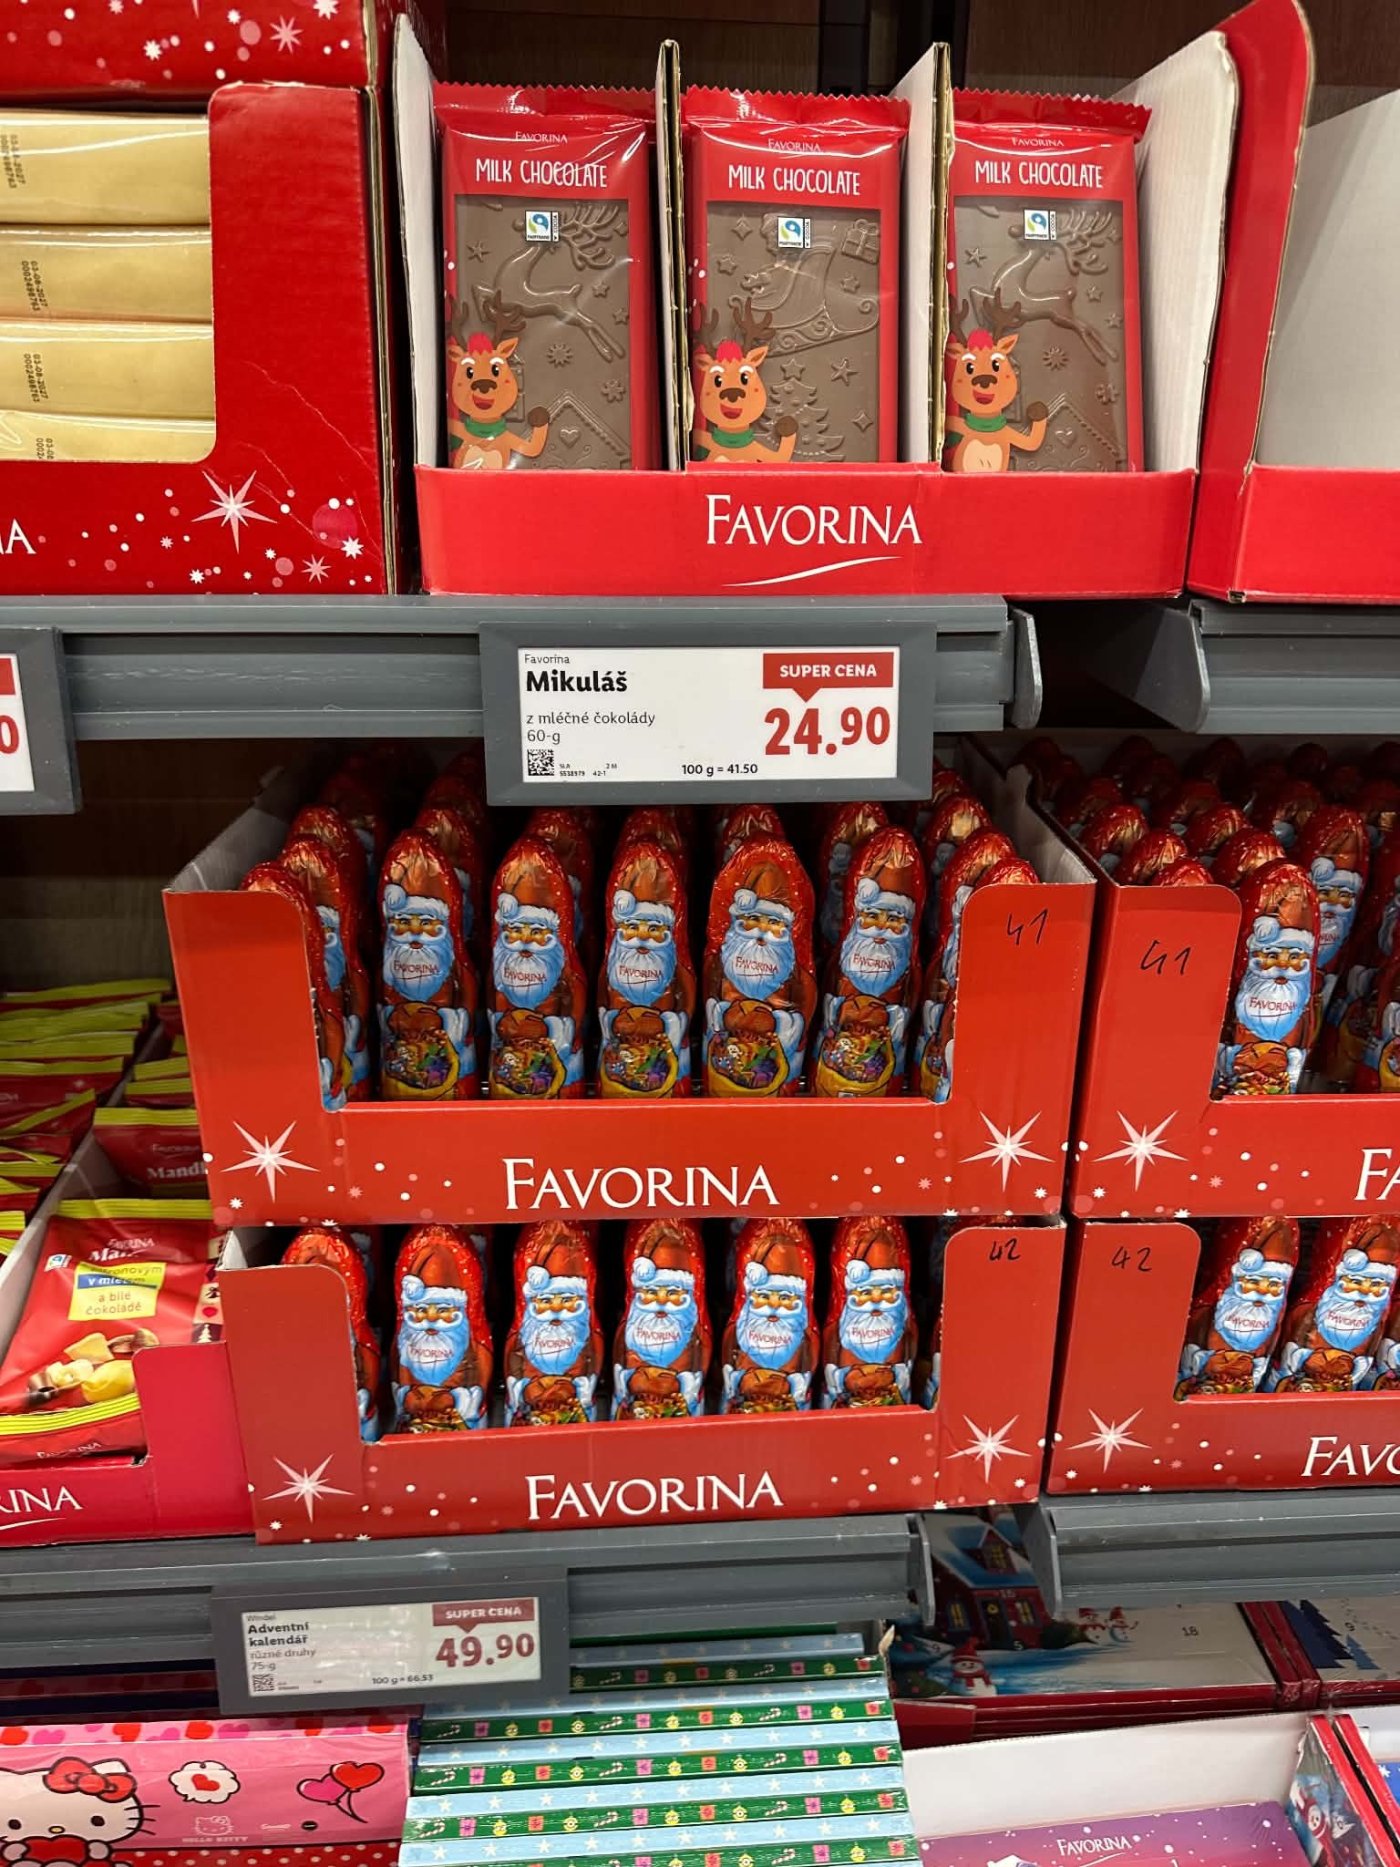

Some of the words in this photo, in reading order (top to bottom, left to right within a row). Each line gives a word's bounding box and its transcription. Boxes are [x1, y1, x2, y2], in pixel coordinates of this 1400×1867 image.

[515, 131, 568, 143] FAVORINA
[1011, 136, 1064, 148] FAVORINA
[768, 138, 821, 152] FAVORINA
[476, 158, 512, 182] MILK
[520, 159, 607, 188] CHOCOLATE
[728, 164, 765, 190] MILK
[773, 167, 860, 196] CHOCOLATE
[975, 160, 1011, 185] MILK
[1018, 161, 1103, 189] CHOCOLATE
[705, 494, 923, 545] FAVORINA
[524, 653, 571, 664] Favorina
[779, 664, 831, 678] SUPER
[834, 663, 878, 677] CENA
[526, 669, 628, 692] Mikuláš
[526, 714, 534, 724] z
[538, 711, 590, 725] mléčné
[593, 711, 656, 728] čokolády
[527, 729, 561, 745] 60-g
[764, 706, 891, 756] 24.90
[681, 764, 703, 775] 100
[706, 766, 715, 777] g
[727, 763, 759, 775] 41.50
[393, 960, 440, 974] FAVORINA
[619, 965, 662, 978] FAVORINA
[735, 956, 779, 973] FAVORINA
[503, 967, 548, 982] FAVORINA
[1249, 996, 1297, 1011] FAVORINA
[502, 1157, 781, 1210] FAVORINA
[989, 1237, 1023, 1262] 42
[1111, 1246, 1153, 1272] 42
[98, 1294, 105, 1302] a
[636, 1328, 680, 1341] FAVORINA
[525, 1470, 784, 1521] FAVORINA
[445, 1608, 486, 1620] SUPER
[489, 1606, 523, 1618] CENA
[248, 1621, 310, 1635] Adventní
[1181, 1625, 1198, 1638] 18
[249, 1634, 309, 1647] kalendář
[250, 1648, 281, 1660] různé
[284, 1647, 316, 1659] druhy
[435, 1632, 535, 1669] 49.90
[372, 1676, 388, 1685] 100
[391, 1678, 399, 1687] g
[407, 1673, 434, 1684] 66.53
[1056, 1834, 1132, 1856] FAVORINA
